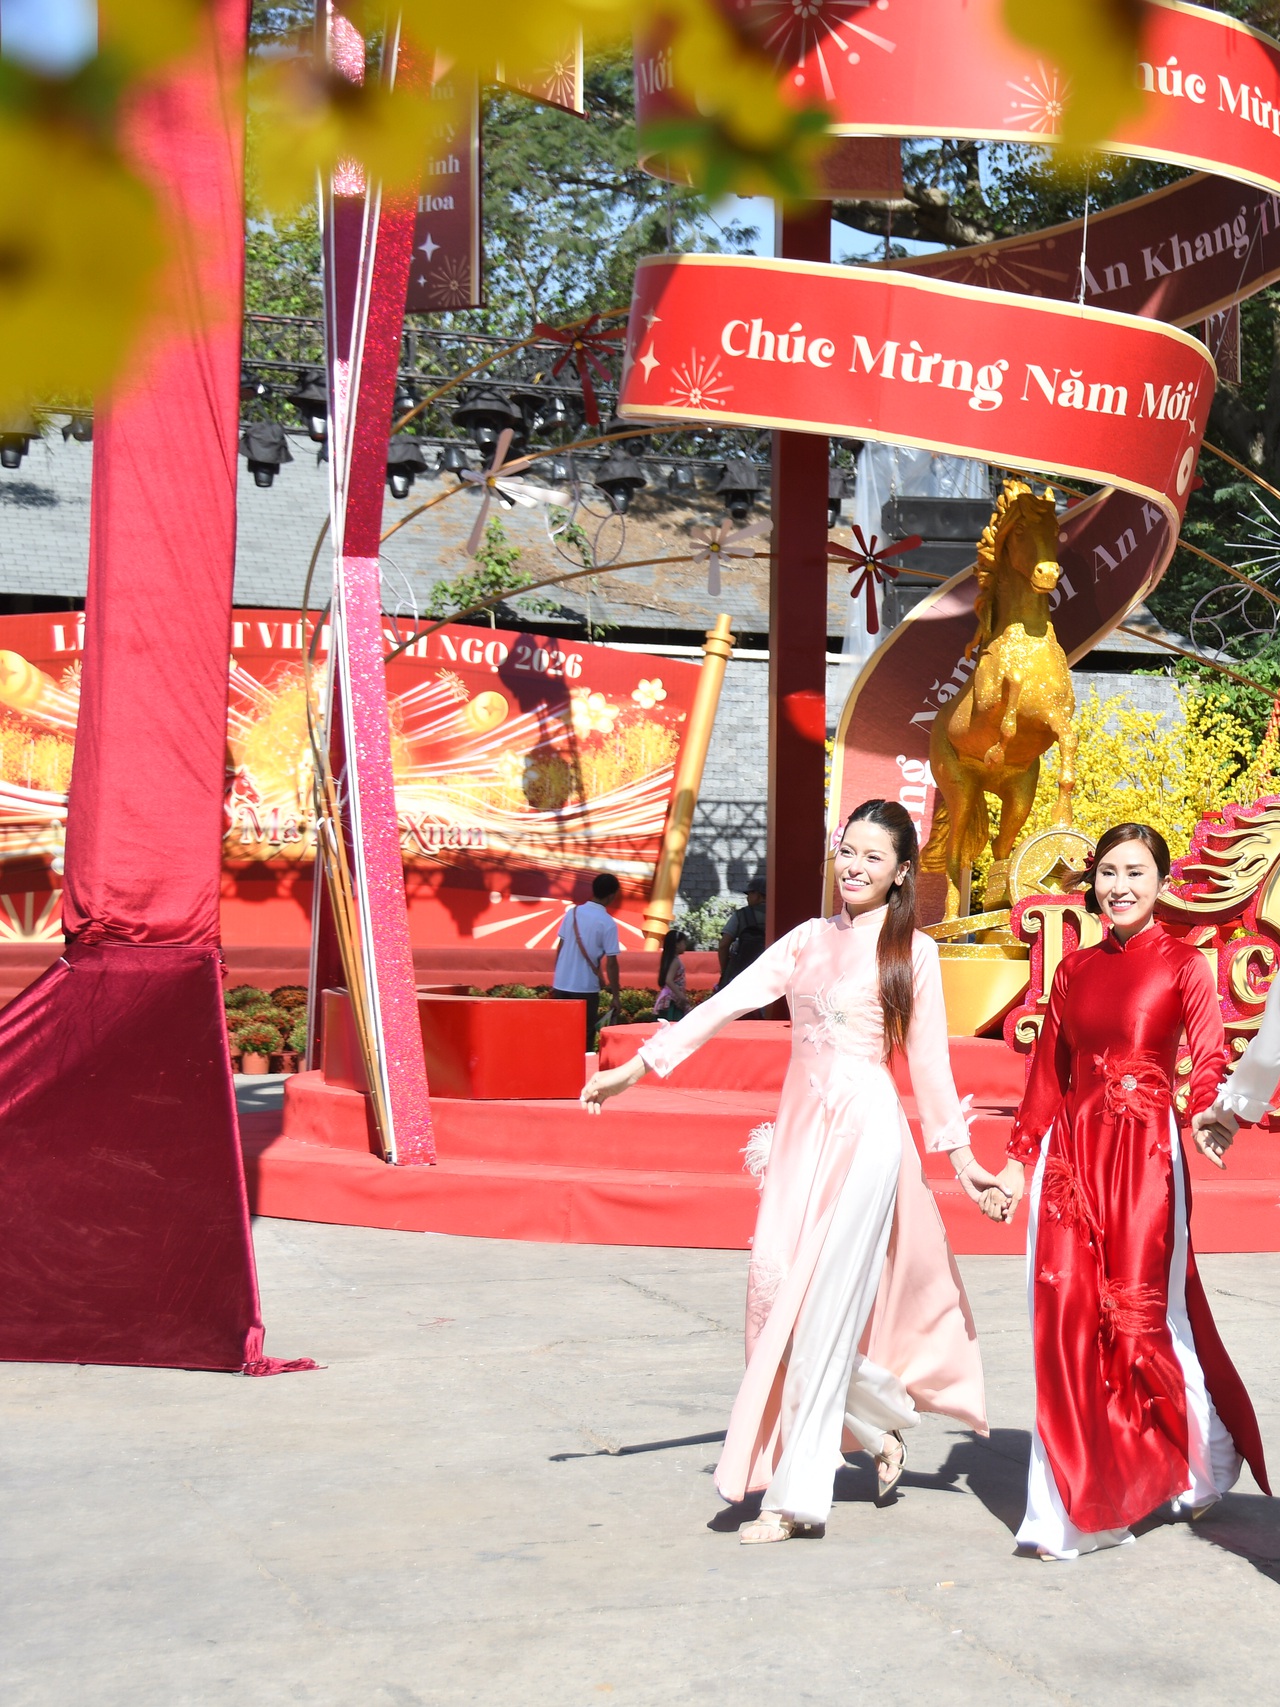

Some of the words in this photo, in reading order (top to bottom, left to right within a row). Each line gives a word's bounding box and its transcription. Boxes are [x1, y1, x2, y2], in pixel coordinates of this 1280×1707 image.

[418, 195, 455, 213] Hoa
[1072, 262, 1132, 299] An
[1141, 205, 1250, 282] Khang
[721, 317, 836, 368] Chúc
[848, 334, 1010, 412] Mừng
[1020, 363, 1129, 416] Năm
[1137, 380, 1194, 422] Mới
[1092, 528, 1139, 584] An
[438, 634, 509, 673] NGỌ
[515, 645, 584, 679] 2026
